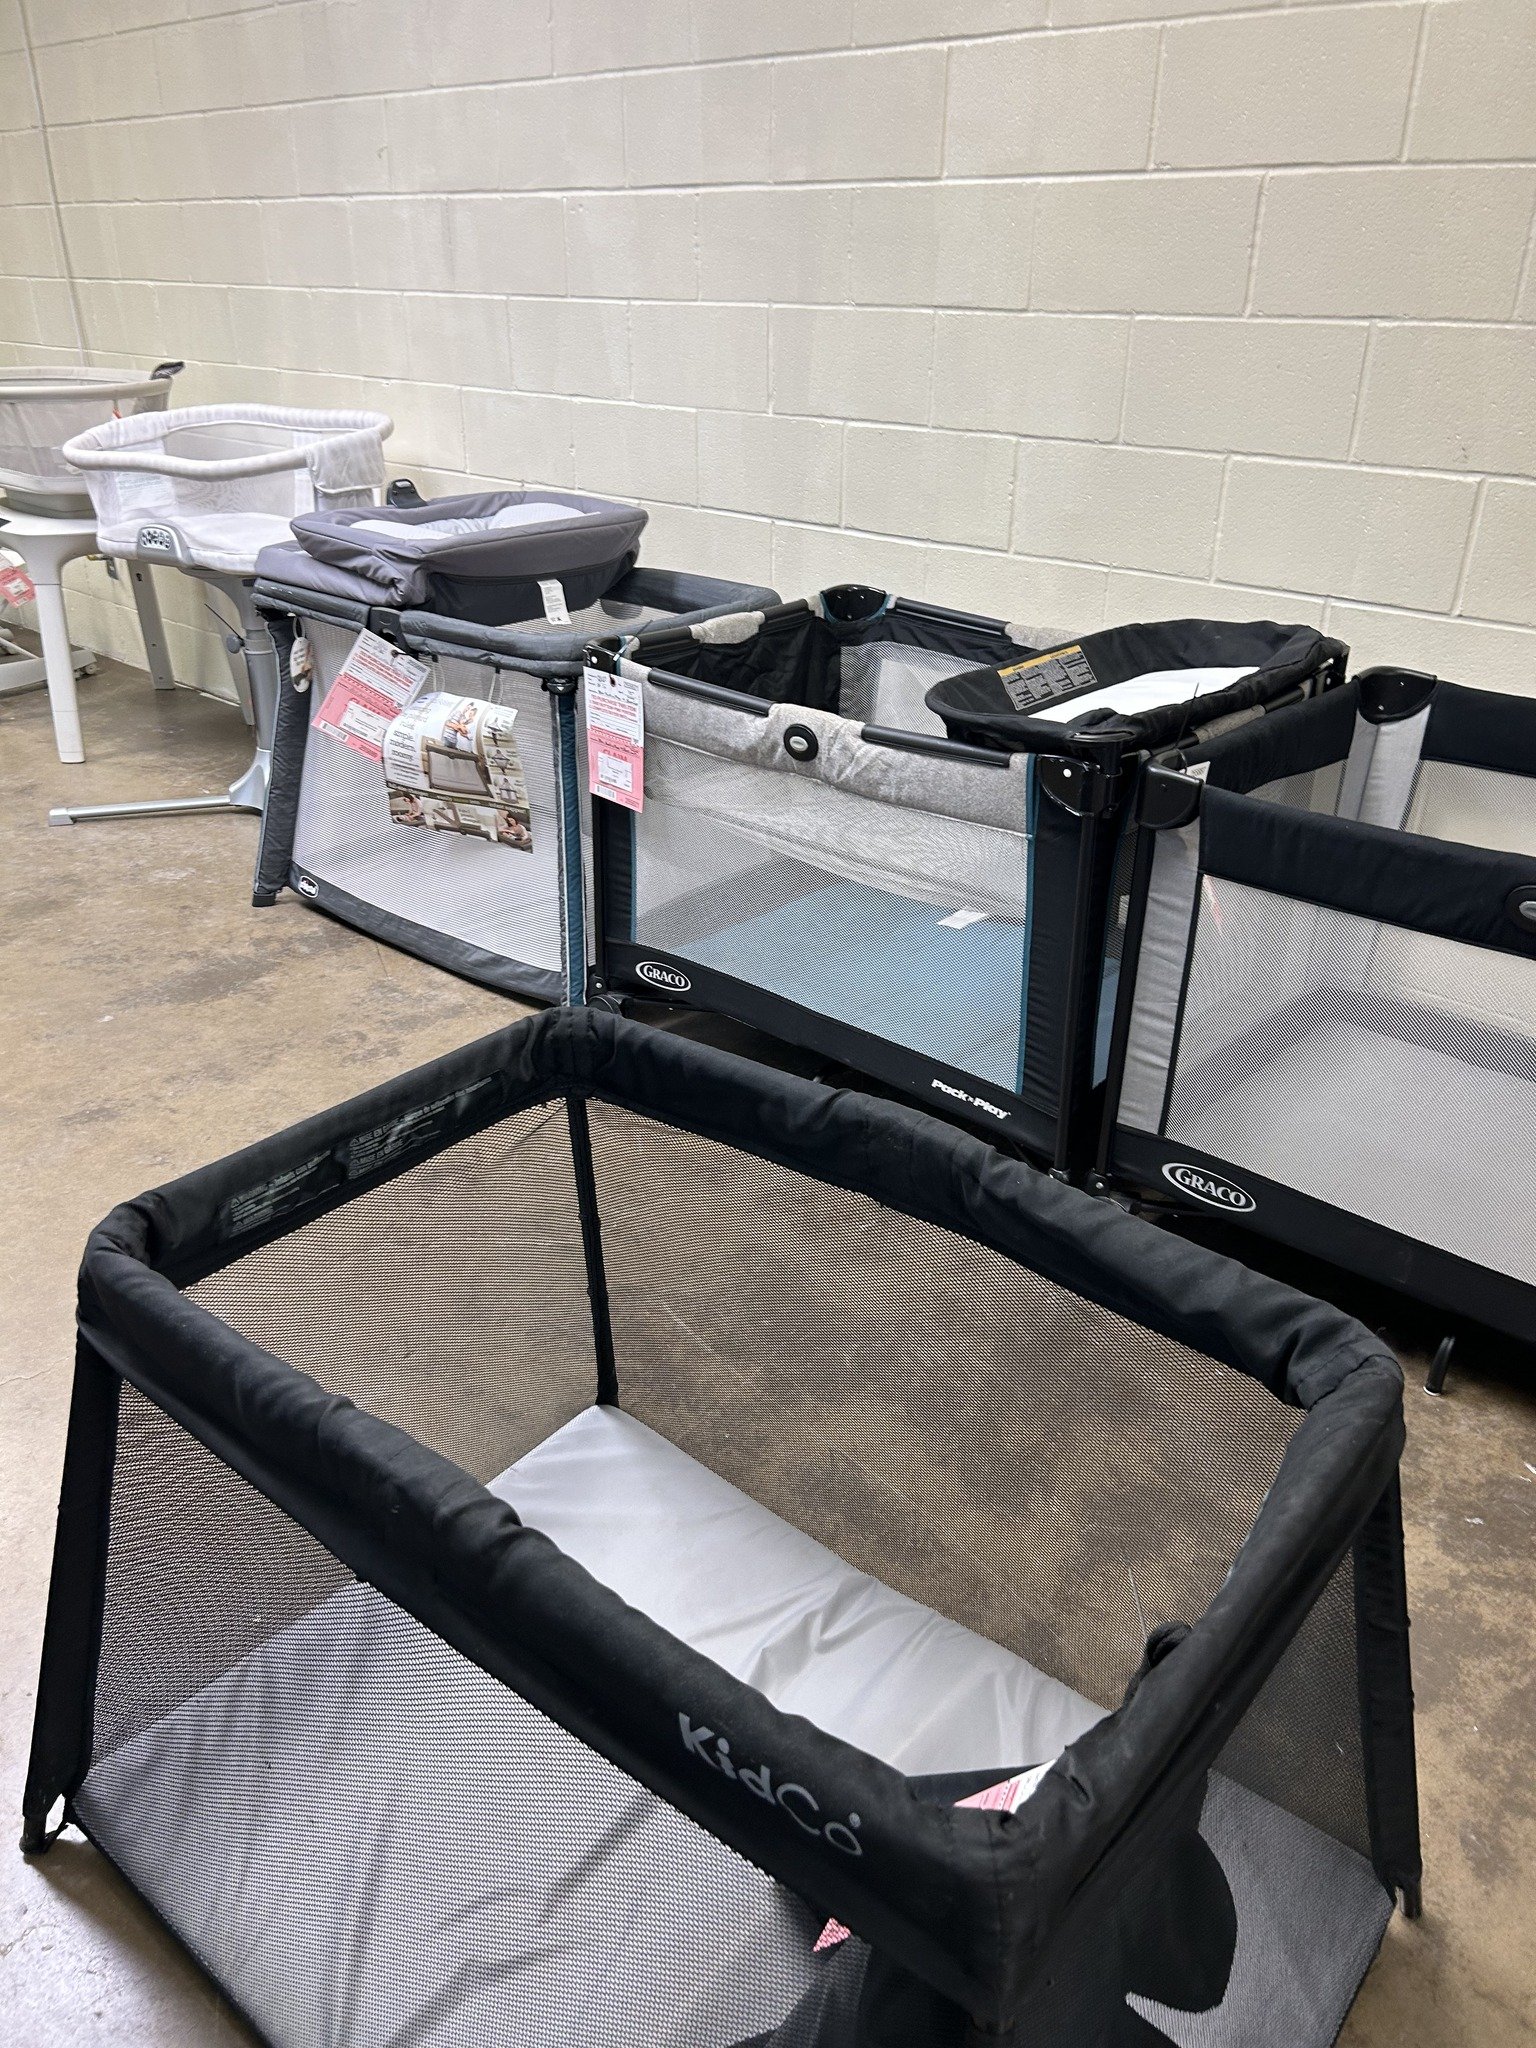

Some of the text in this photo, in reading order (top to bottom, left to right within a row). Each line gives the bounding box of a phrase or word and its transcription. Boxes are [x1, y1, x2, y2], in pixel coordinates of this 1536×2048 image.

[643, 965, 684, 987] GRACO
[931, 1078, 968, 1101] Pack
[1175, 1168, 1246, 1207] GRACO
[679, 1712, 863, 1856] KidCo
